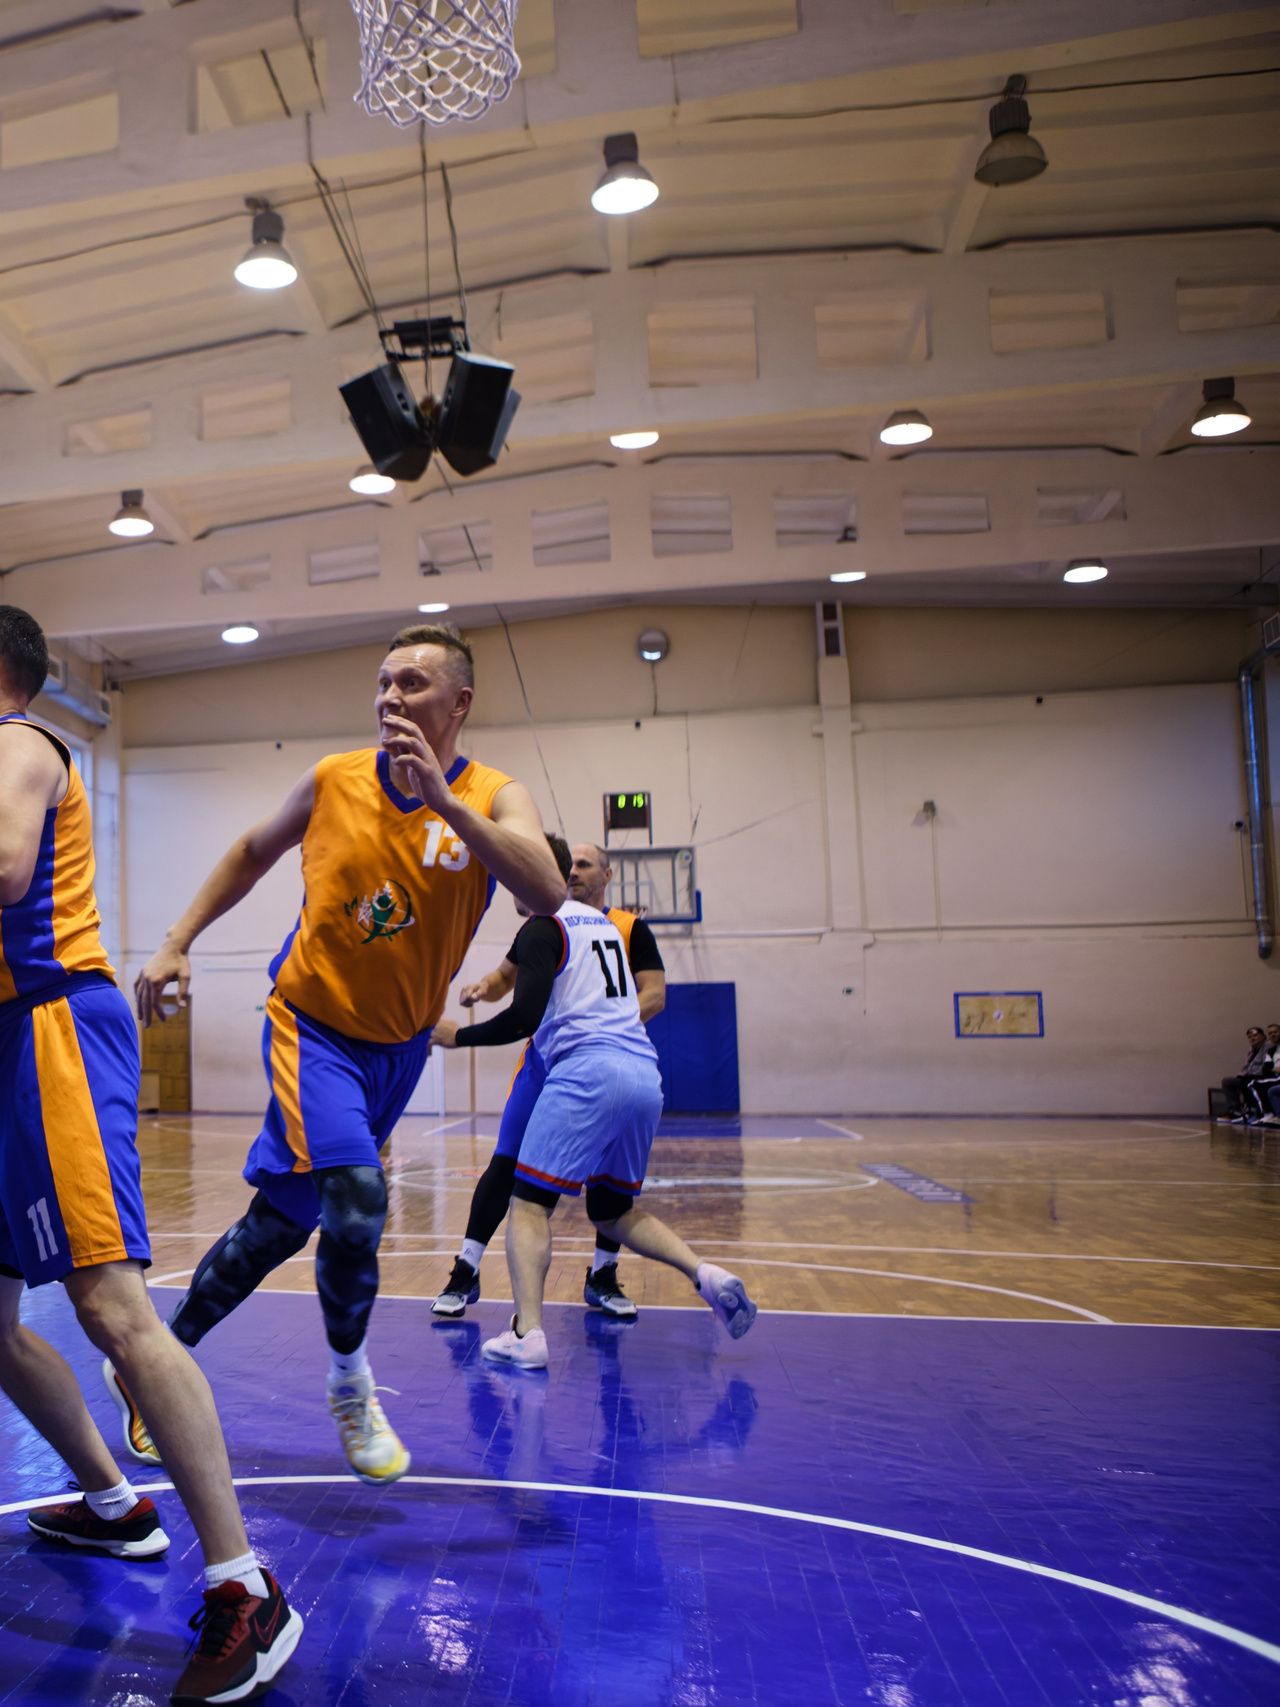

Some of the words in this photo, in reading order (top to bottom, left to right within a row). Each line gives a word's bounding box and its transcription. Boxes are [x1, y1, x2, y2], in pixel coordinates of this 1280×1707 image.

[422, 820, 471, 872] 13
[591, 939, 628, 998] 17
[26, 1196, 60, 1263] 11
